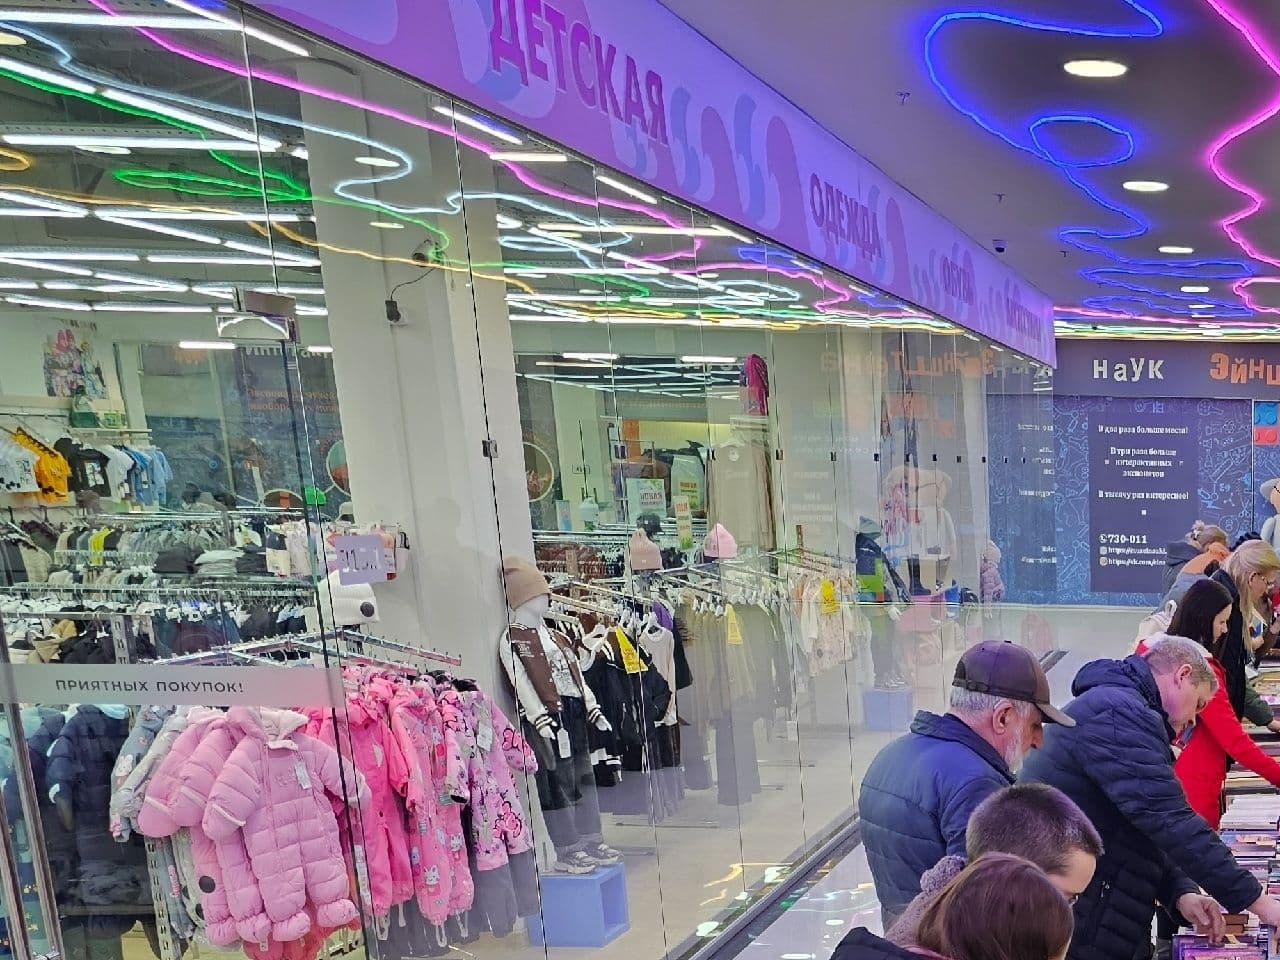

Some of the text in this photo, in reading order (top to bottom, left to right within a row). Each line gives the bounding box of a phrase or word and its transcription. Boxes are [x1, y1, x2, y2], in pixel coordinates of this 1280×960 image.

[491, 0, 668, 146] ДЕТСКАЯ
[809, 173, 883, 257] ОДЕЖДА
[1093, 358, 1164, 382] наук
[1108, 535, 1147, 543] 730-011
[55, 679, 243, 694] ПРИЯТНЫХ ПОКУПОК!
